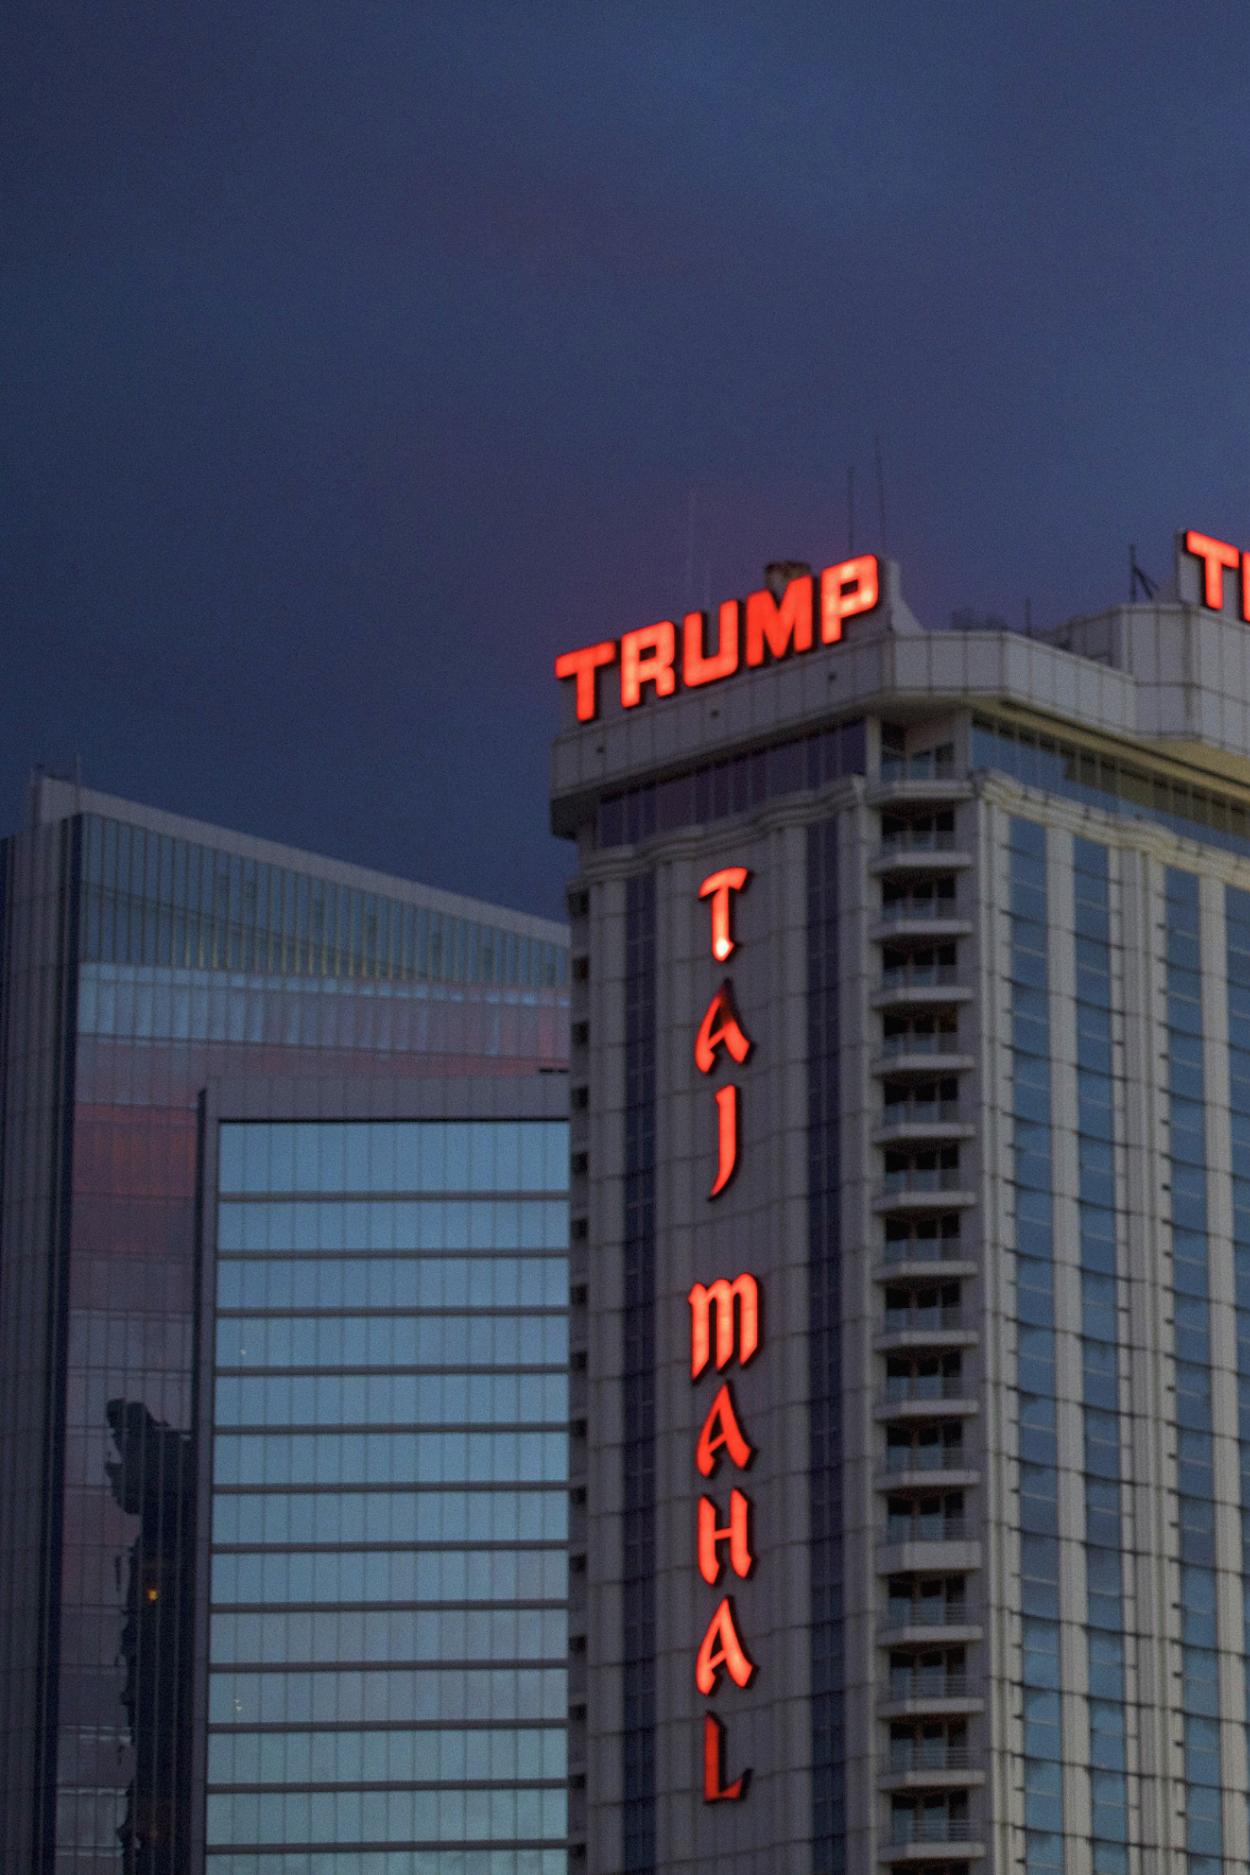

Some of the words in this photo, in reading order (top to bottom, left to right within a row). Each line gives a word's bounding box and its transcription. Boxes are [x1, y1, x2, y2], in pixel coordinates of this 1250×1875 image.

[555, 554, 879, 722] TRUMP
[694, 866, 749, 1200] TAJ
[688, 1273, 758, 1804] MAHAL
